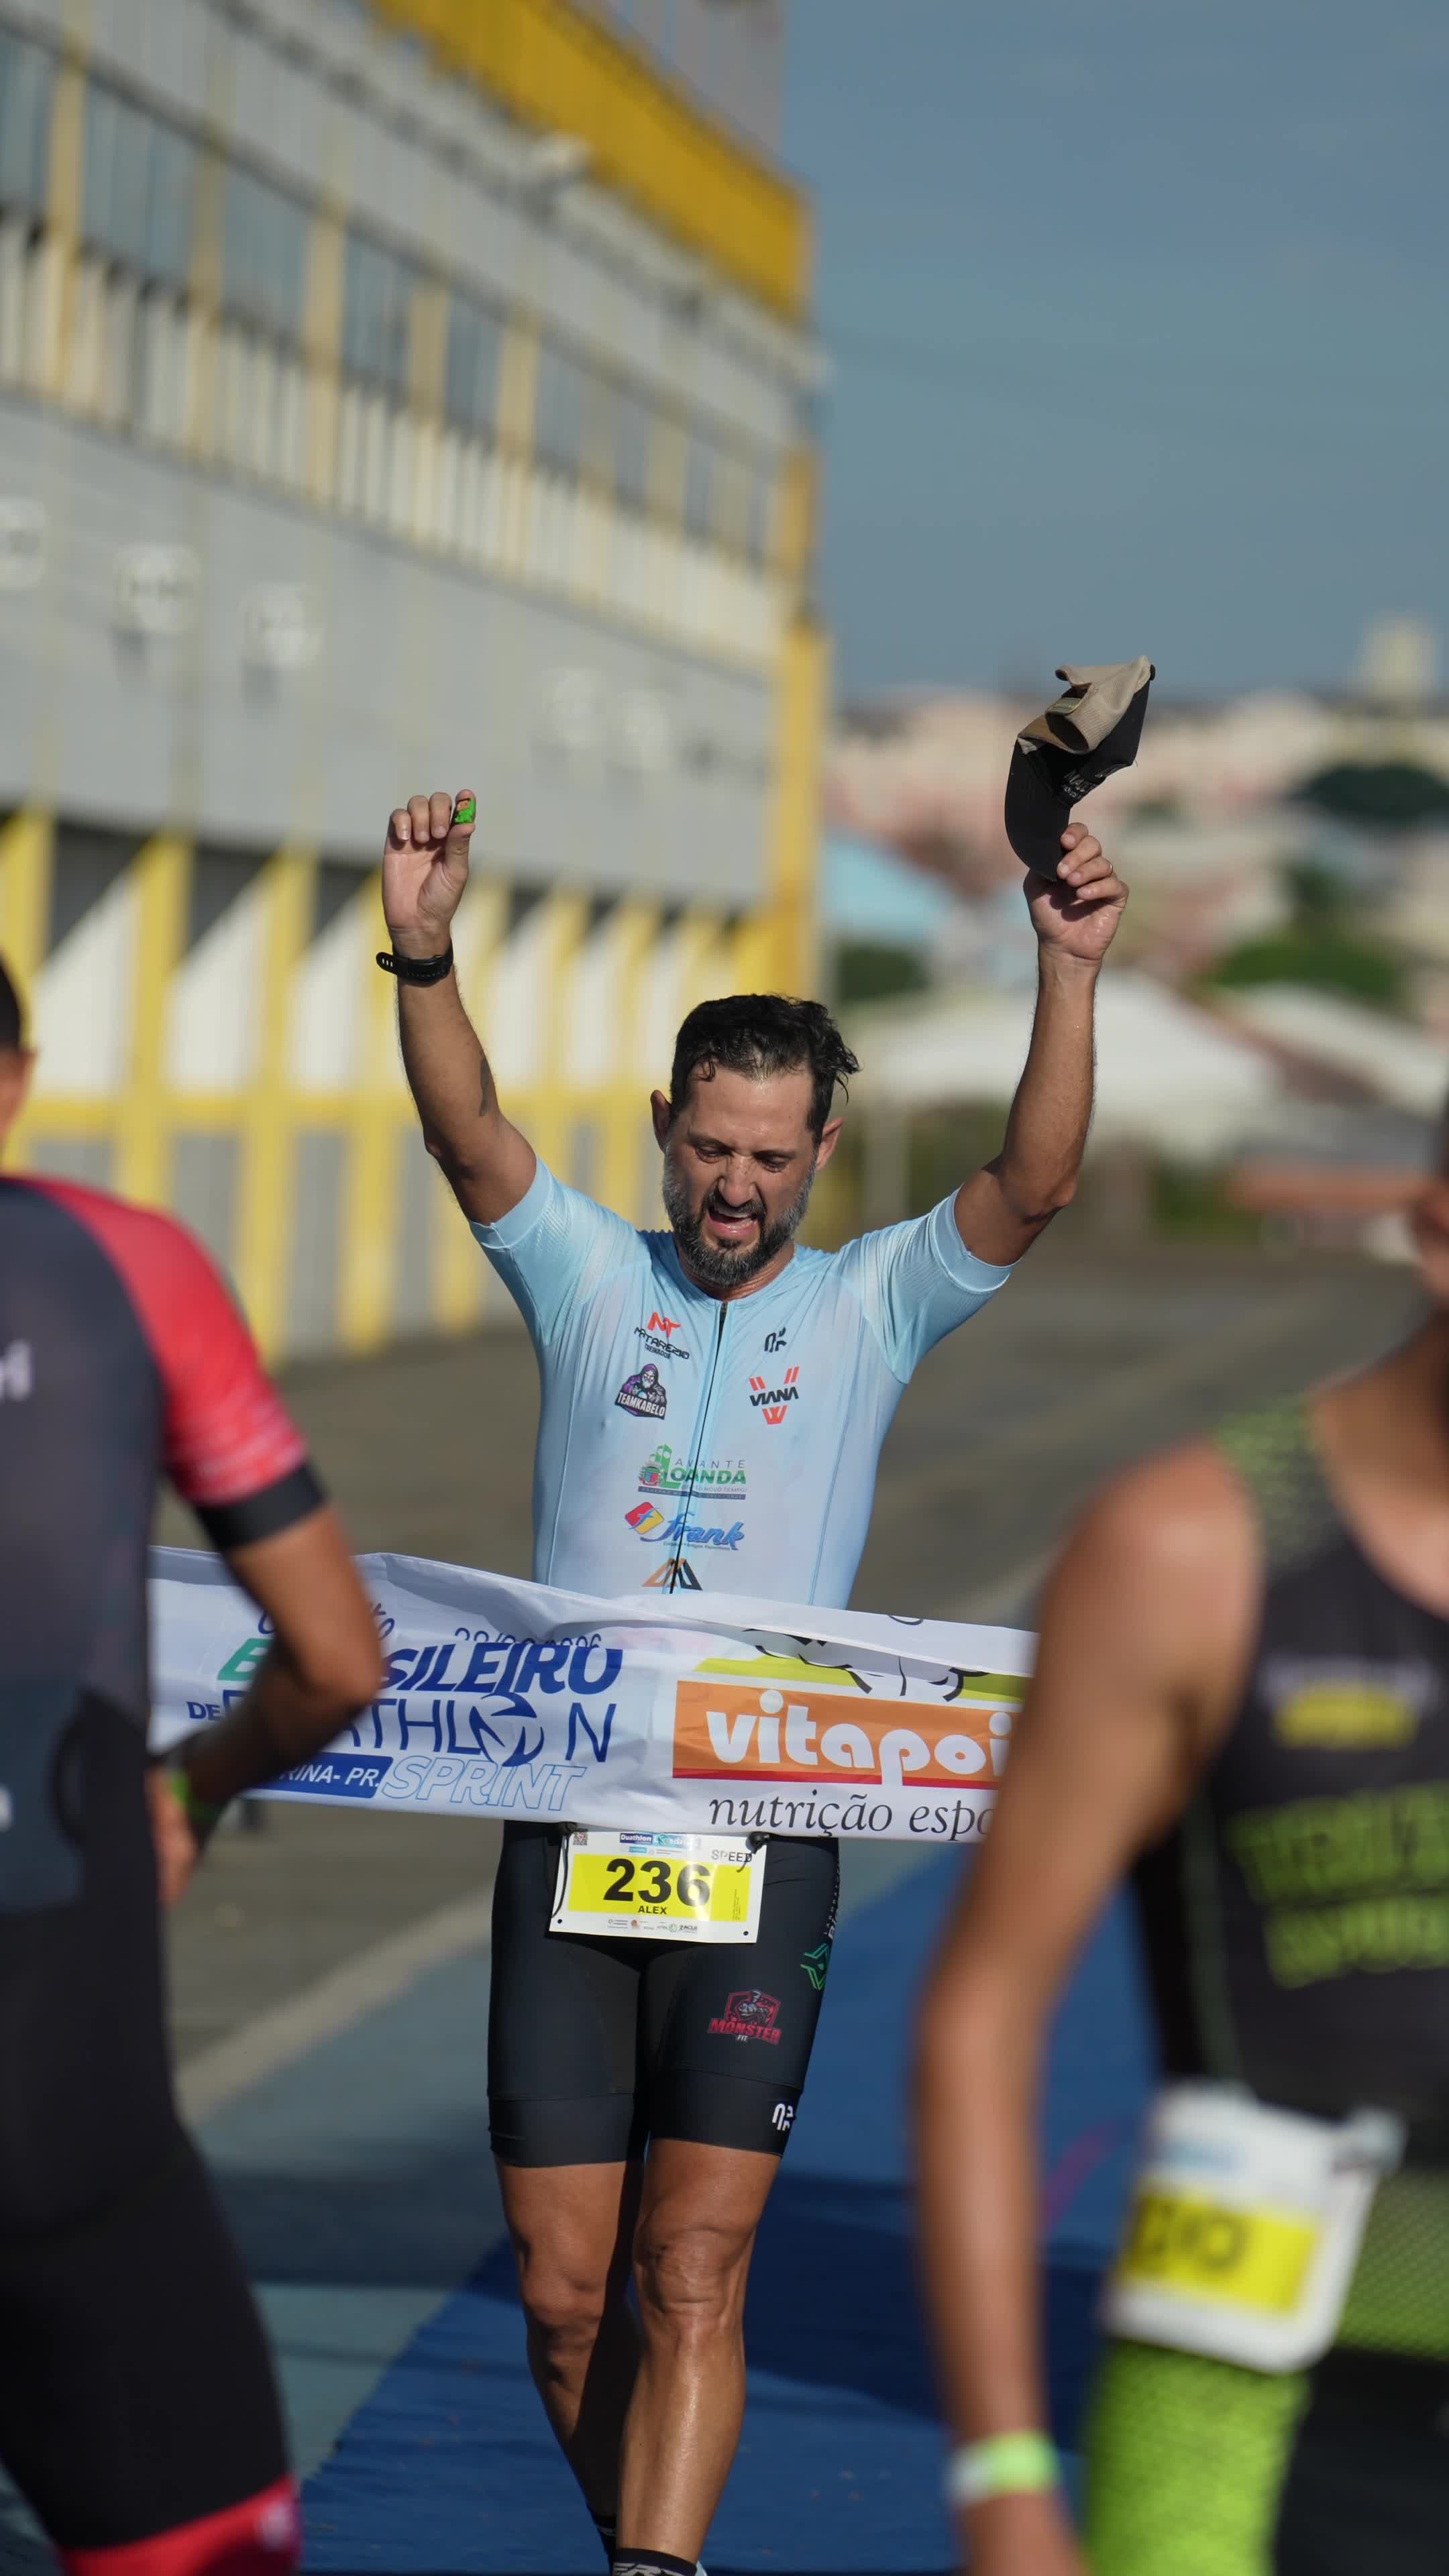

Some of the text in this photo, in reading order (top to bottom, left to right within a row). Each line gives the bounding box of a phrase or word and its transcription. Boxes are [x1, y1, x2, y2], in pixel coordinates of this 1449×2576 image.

[617, 1393, 665, 1417] TEAMKABELO
[749, 1386, 799, 1406] VIANA
[675, 1458, 745, 1469] AVANTE
[217, 1638, 623, 1695] BSILEIRO
[381, 1756, 588, 1811] SPRINT
[710, 1789, 892, 1837] nutrição
[620, 1833, 652, 1842] Duathlon
[711, 1849, 752, 1862] SPEED
[603, 1858, 710, 1907] 236
[638, 1905, 667, 1915] ALEX
